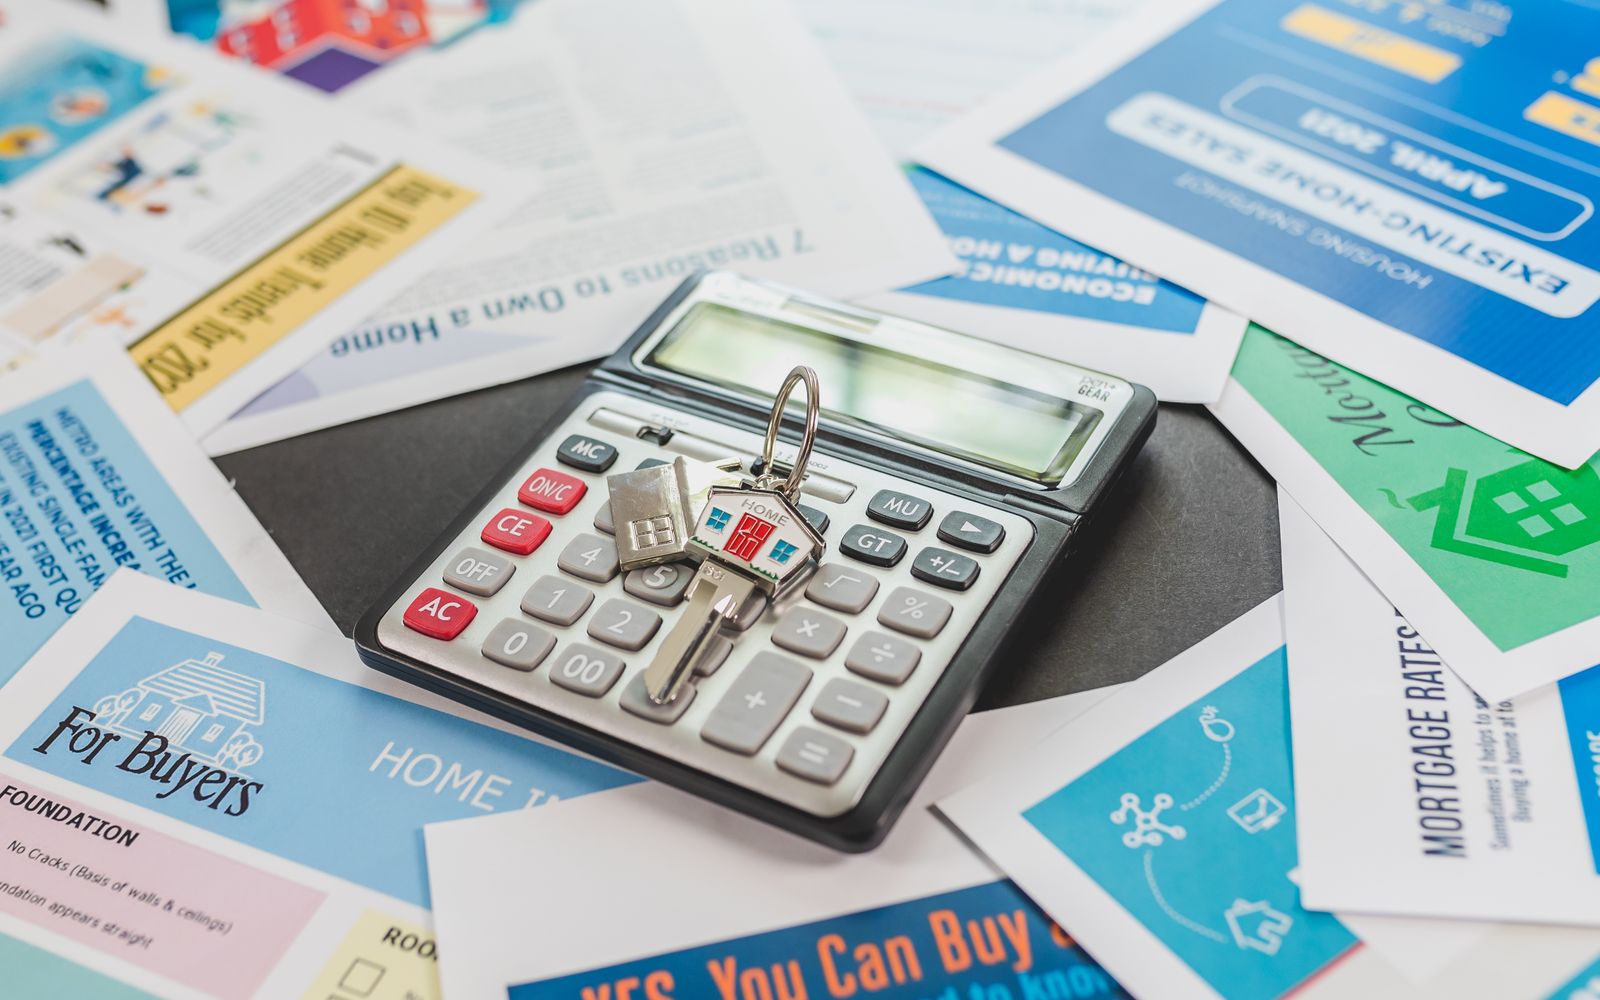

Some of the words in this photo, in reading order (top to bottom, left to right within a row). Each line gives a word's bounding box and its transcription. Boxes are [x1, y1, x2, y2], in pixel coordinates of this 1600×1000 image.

[1391, 140, 1507, 200] APRIL
[1172, 170, 1308, 237] SNAPSHOT
[791, 227, 815, 255] 7
[1255, 155, 1570, 296] EXISTING-HOME
[624, 239, 782, 290] Reasons
[1006, 243, 1034, 264] A
[1305, 228, 1434, 290] HOUSING
[481, 286, 567, 323] Own
[574, 273, 612, 300] to
[449, 307, 471, 329] a
[330, 316, 440, 358] Home
[1077, 384, 1111, 402] GEAR
[569, 438, 606, 460] MC
[26, 419, 101, 516] PERCENTAGE
[528, 474, 573, 502] ON/C
[88, 456, 136, 510] AREAS
[124, 502, 167, 553] WITH
[155, 540, 190, 585] THE
[740, 498, 790, 527] HOME
[882, 496, 920, 517] MU
[496, 513, 534, 537] CE
[857, 533, 893, 553] GT
[27, 539, 70, 588] FIRST
[455, 557, 499, 582] OFF
[579, 546, 605, 567] 4
[646, 565, 674, 588] 5
[10, 581, 47, 621] AGO
[418, 595, 462, 622] AC
[549, 588, 569, 608] 1
[606, 610, 634, 635] 2
[1395, 624, 1447, 701] RATES
[1472, 711, 1492, 727] to
[33, 705, 121, 767] For
[115, 729, 265, 818] Buyers
[1475, 727, 1499, 763] helps
[1502, 731, 1524, 765] home
[368, 740, 513, 812] HOME
[1405, 707, 1468, 859] MORTGAGE
[0, 784, 141, 848] FOUNDATION
[7, 838, 26, 856] No
[28, 847, 71, 873] Cracks
[69, 863, 111, 888] (Basis
[111, 880, 129, 895] of
[128, 888, 162, 909] walls
[162, 899, 177, 914] &
[48, 901, 100, 929] appears
[101, 921, 155, 950] straight
[382, 925, 439, 963] ROO
[815, 932, 924, 999] Can
[927, 908, 1033, 974] Buy
